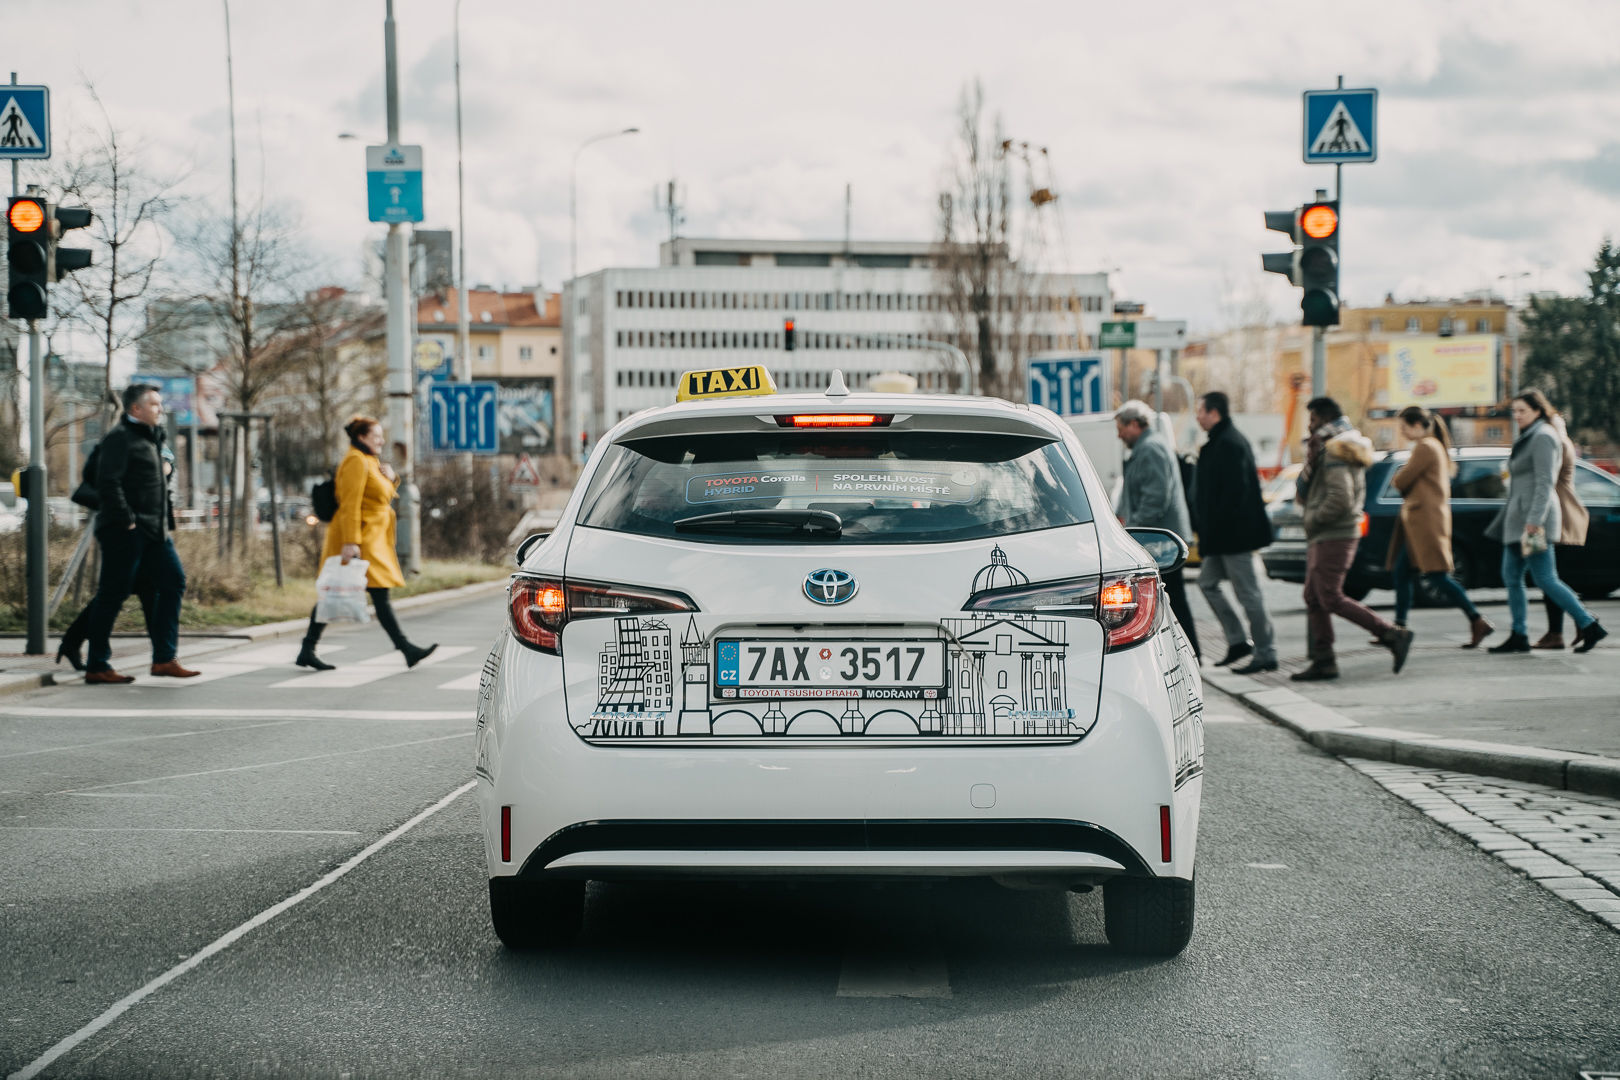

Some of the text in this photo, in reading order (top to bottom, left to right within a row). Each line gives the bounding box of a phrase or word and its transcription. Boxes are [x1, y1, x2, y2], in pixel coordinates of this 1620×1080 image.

[692, 368, 757, 393] TAXI
[705, 475, 806, 487] TOYOTA Corolla
[833, 474, 936, 484] SPOLEHLIVOST
[704, 485, 755, 496] HYBRID
[855, 482, 907, 492] PRVNÍM
[910, 485, 951, 495] MÍSTĚ
[748, 647, 925, 681] 7AX 3517
[721, 670, 737, 680] CZ
[743, 689, 860, 697] TOYOTA TSUSHO PRAHA
[866, 689, 920, 699] MODŘANY
